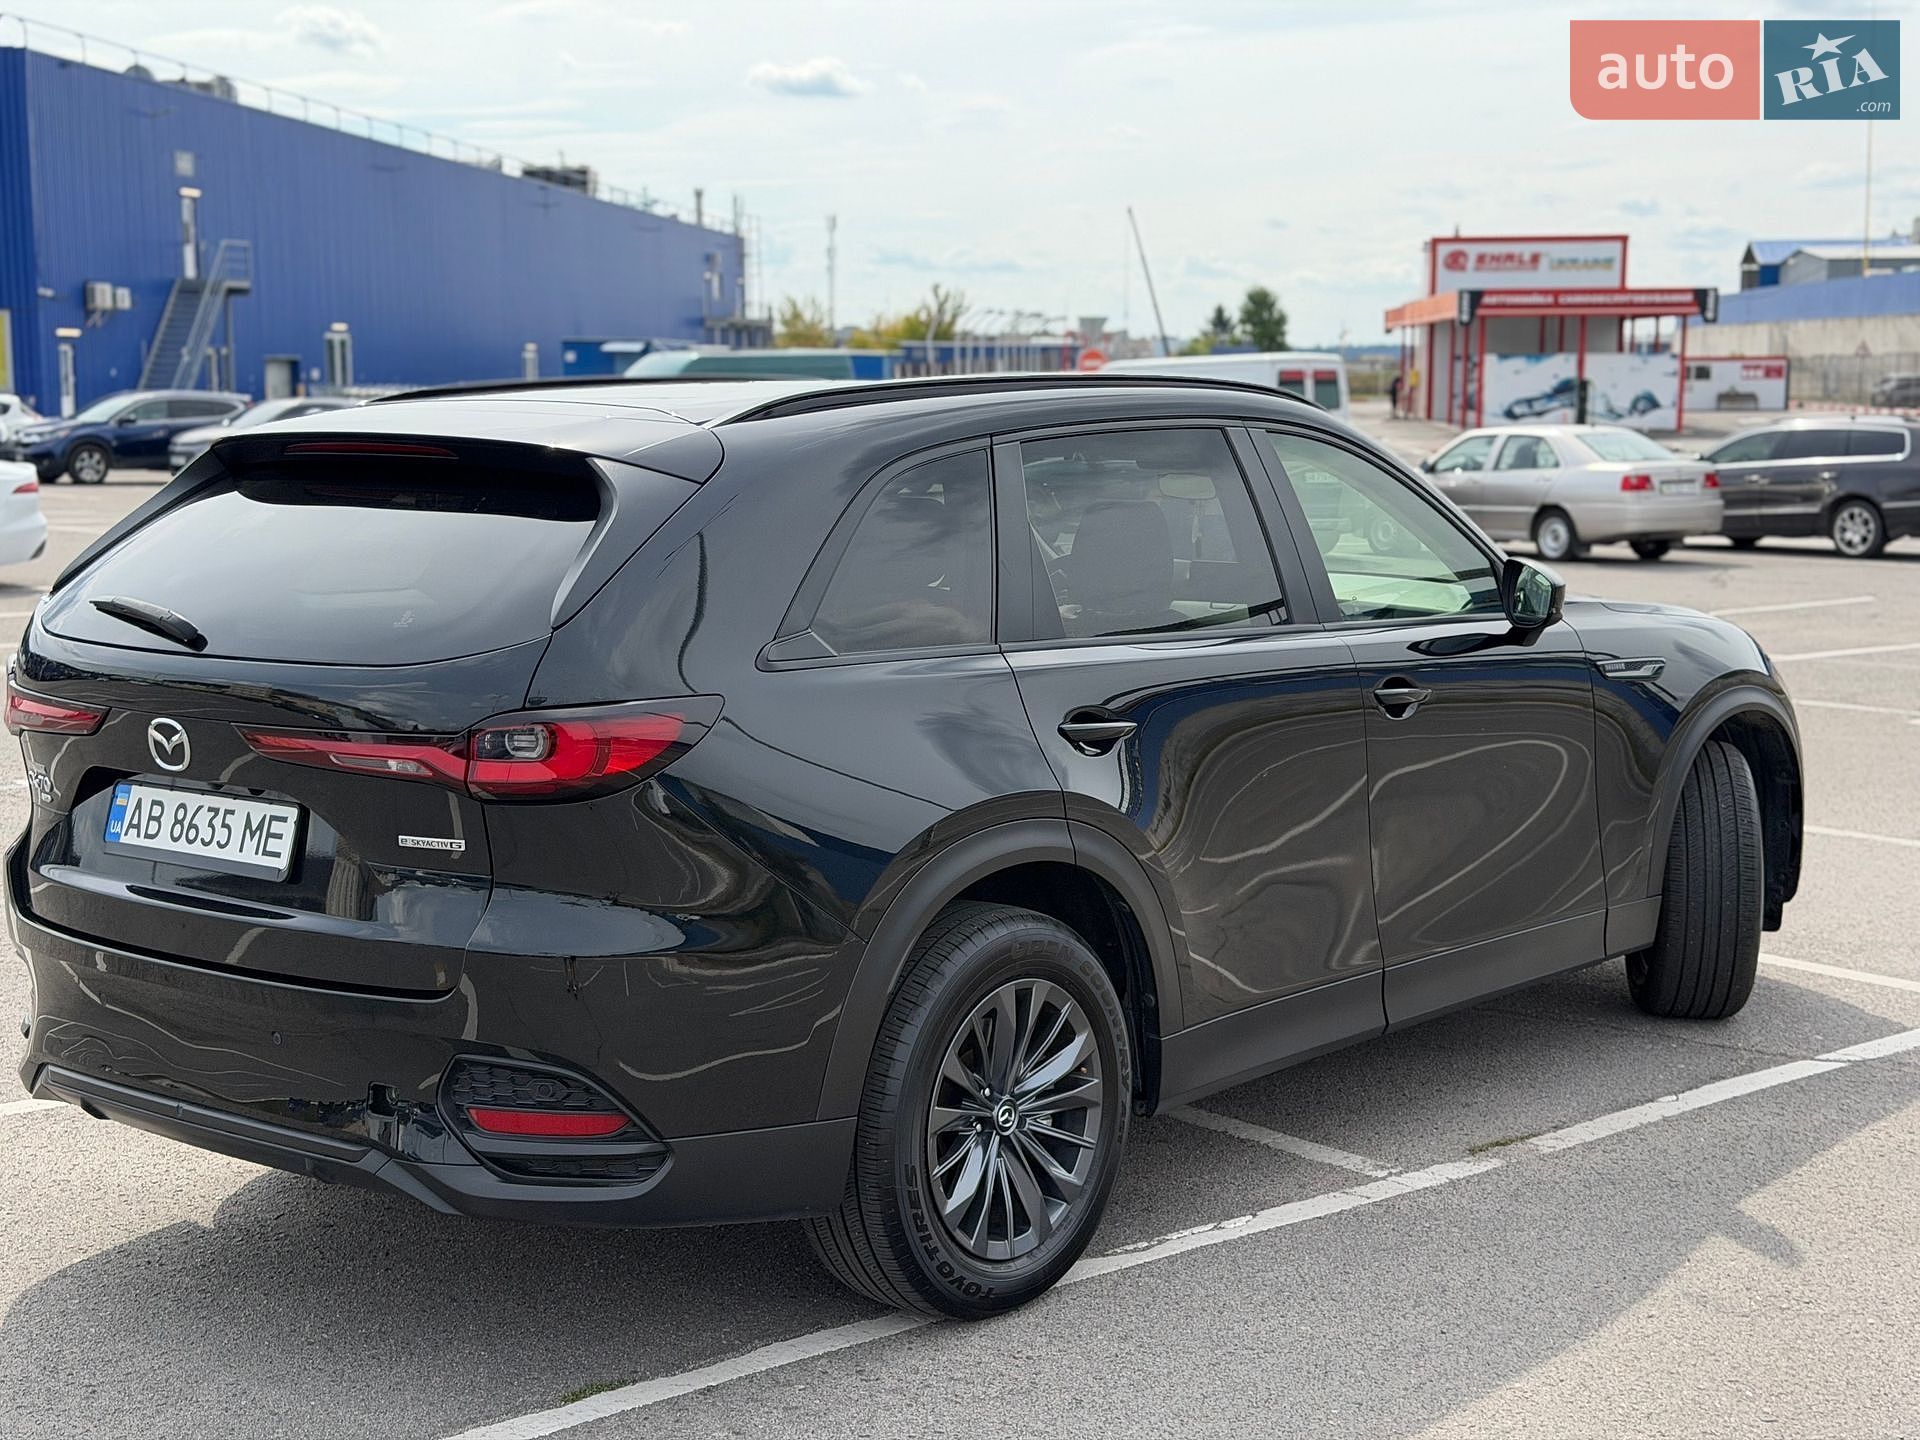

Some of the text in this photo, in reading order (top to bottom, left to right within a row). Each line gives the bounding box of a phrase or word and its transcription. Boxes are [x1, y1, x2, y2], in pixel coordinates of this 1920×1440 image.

[110, 819, 121, 834] UA
[124, 797, 289, 859] AB 8635 ME
